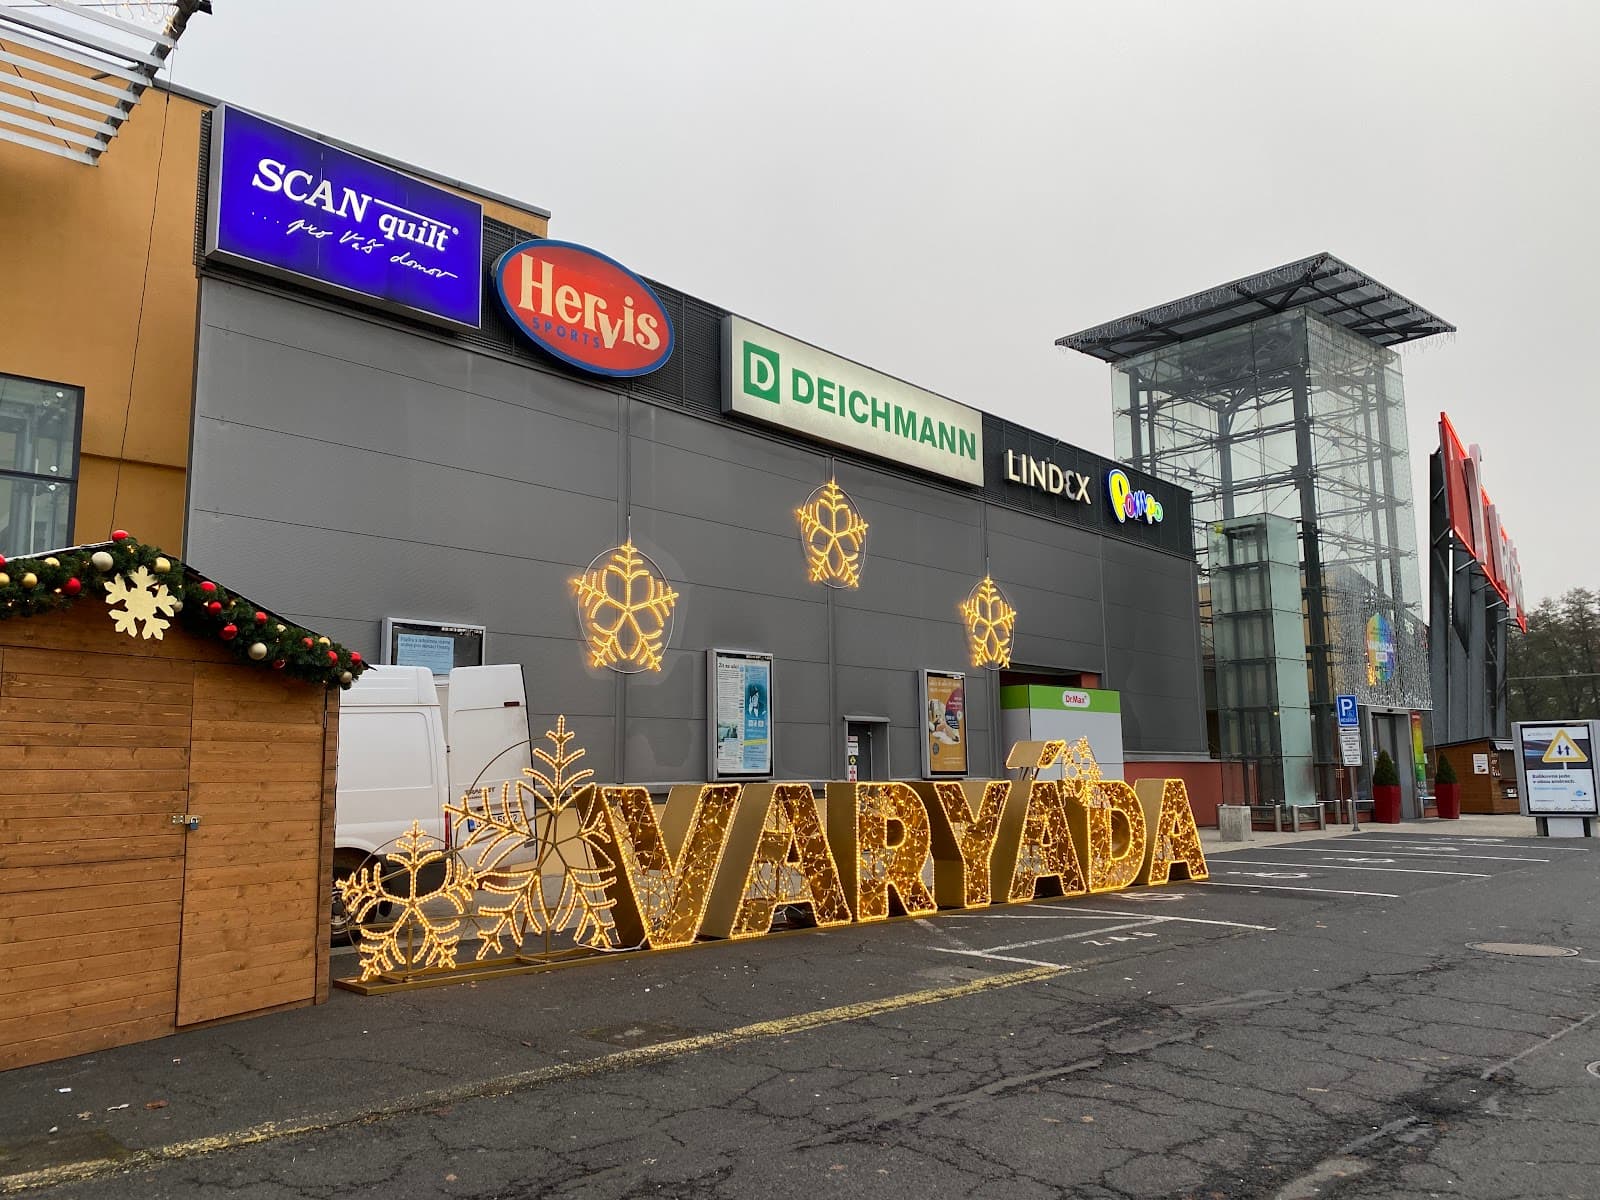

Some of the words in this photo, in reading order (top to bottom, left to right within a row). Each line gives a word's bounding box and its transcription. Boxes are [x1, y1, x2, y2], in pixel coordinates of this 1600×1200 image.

[252, 158, 372, 223] SCAN
[390, 251, 459, 279] domov
[518, 253, 661, 351] Hervis
[532, 316, 601, 350] SPORTS
[750, 351, 775, 392] D
[791, 367, 977, 461] DEICHMANN
[1005, 449, 1092, 505] LINDEX
[1107, 468, 1165, 525] Pompo
[1341, 699, 1353, 716] P
[599, 779, 1210, 949] VARYADA
